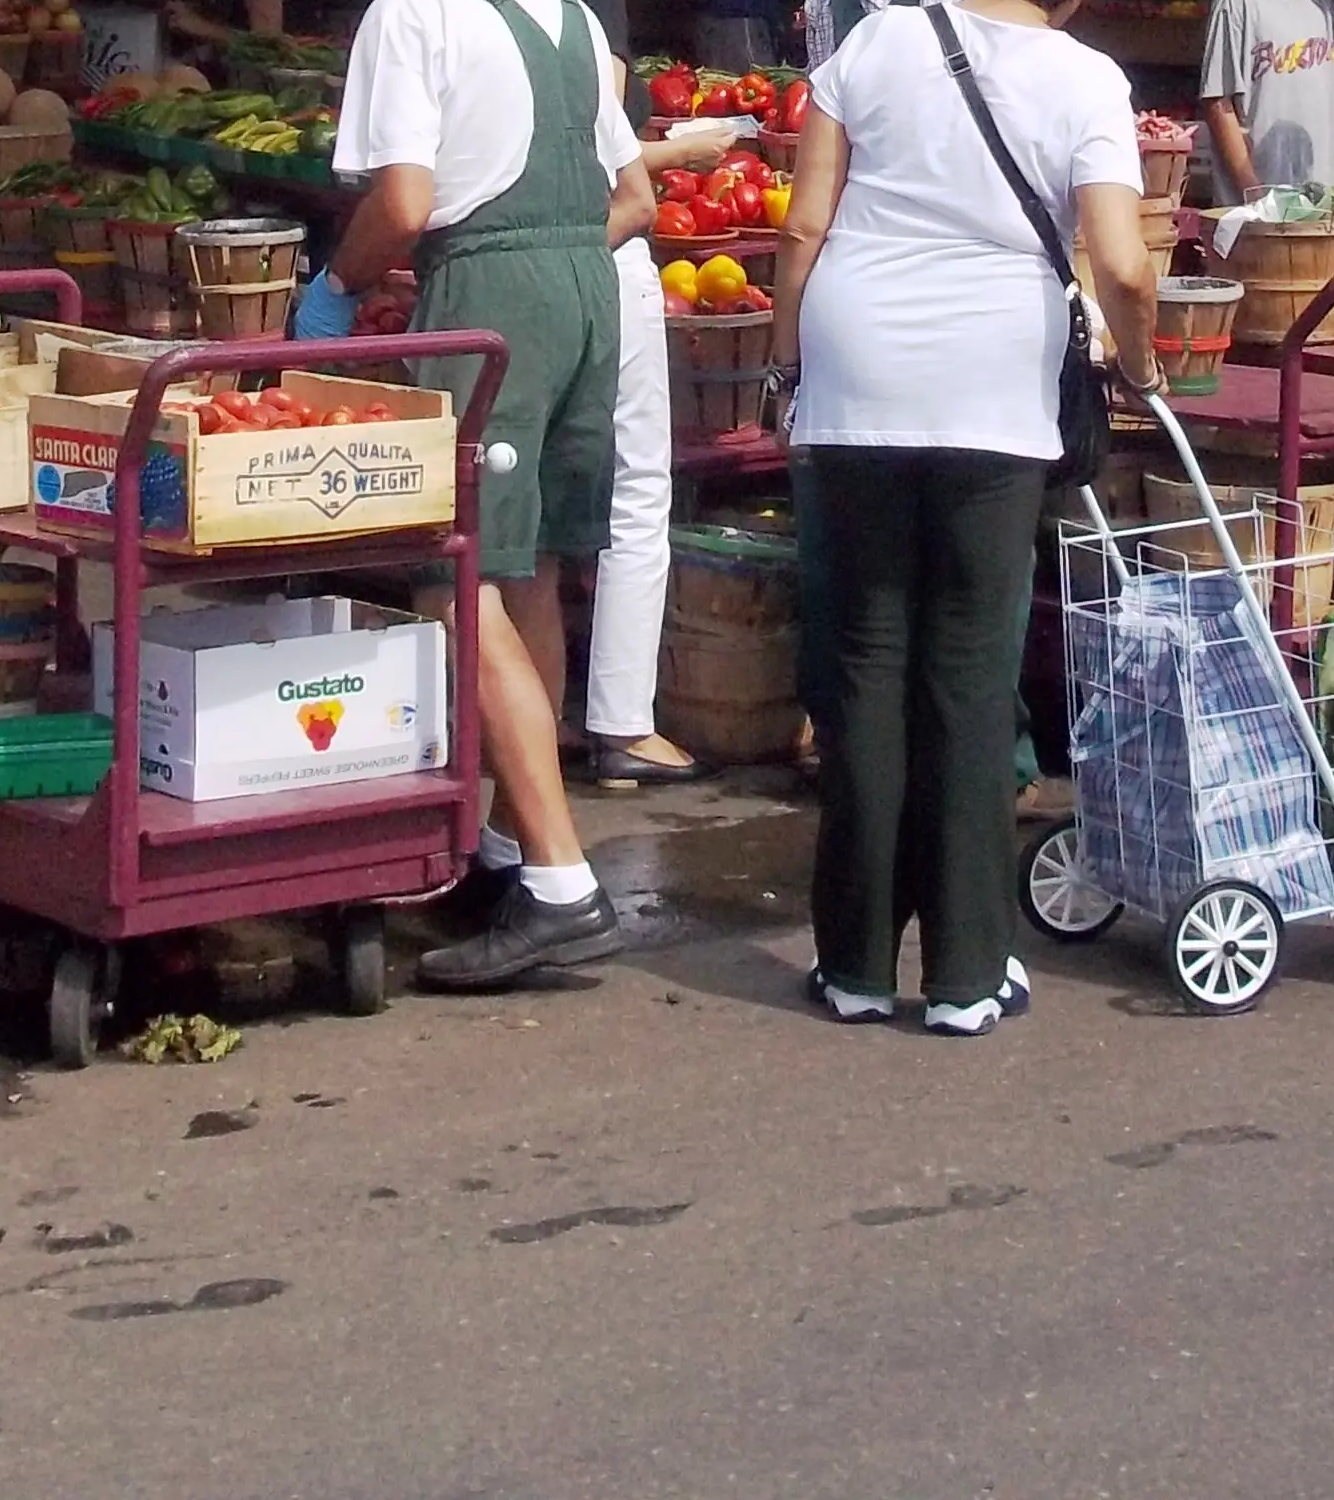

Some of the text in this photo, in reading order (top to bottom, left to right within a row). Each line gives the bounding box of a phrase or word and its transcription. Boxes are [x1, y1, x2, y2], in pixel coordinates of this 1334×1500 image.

[35, 436, 80, 465] SANTA
[248, 442, 413, 474] PRIMA QUALITA
[248, 469, 420, 499] NET 36 WEIGHT
[277, 673, 364, 702] Gustato
[293, 766, 332, 781] SWEET
